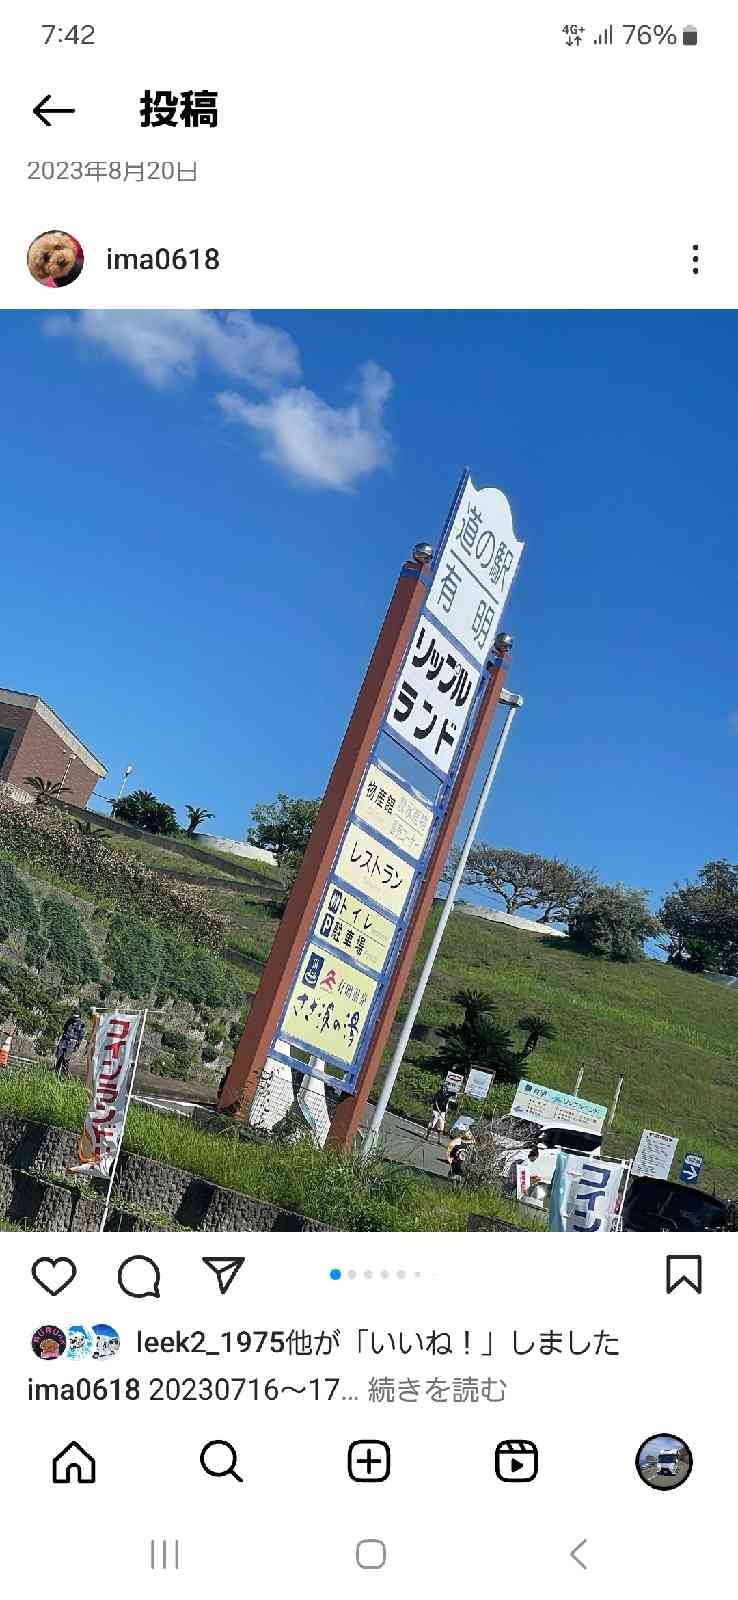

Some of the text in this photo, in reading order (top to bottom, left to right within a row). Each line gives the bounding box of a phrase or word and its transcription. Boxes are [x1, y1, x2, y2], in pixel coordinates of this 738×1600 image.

[42, 25, 94, 44] 7:42
[623, 24, 677, 44] 76%
[139, 90, 218, 128] 投稿
[27, 162, 196, 182] 2023年8月20日
[108, 248, 219, 270] ima0618
[456, 502, 514, 592] 道の駅
[411, 626, 472, 707] リップル
[393, 681, 457, 754] ランド
[349, 841, 404, 890] レストラン
[339, 897, 372, 930] トイレ
[28, 1378, 139, 1400] ima0618
[368, 1376, 507, 1402] 続きを読む
